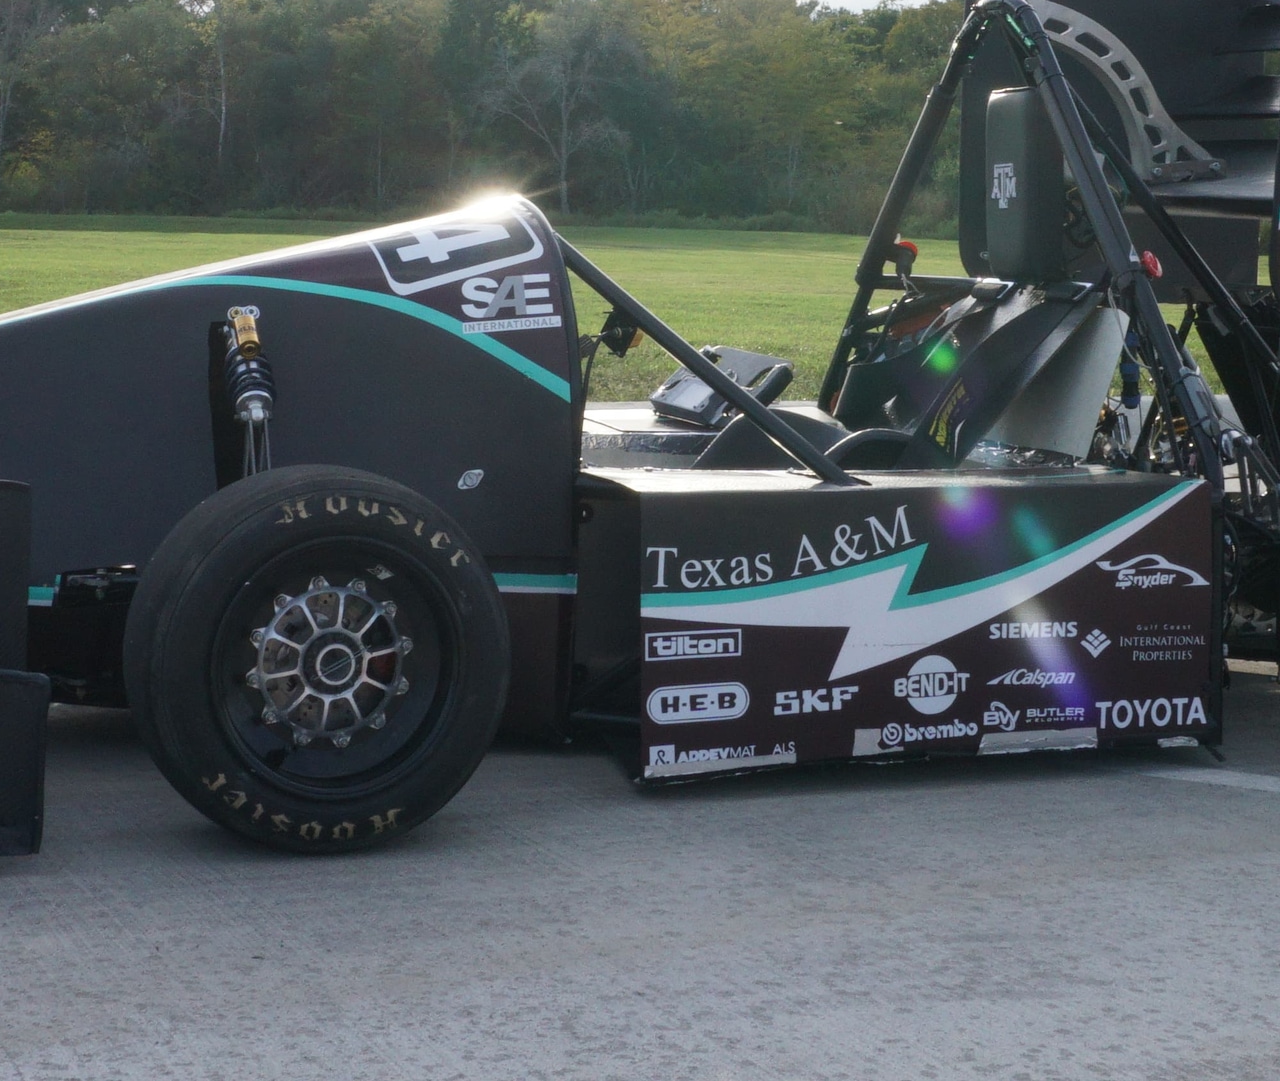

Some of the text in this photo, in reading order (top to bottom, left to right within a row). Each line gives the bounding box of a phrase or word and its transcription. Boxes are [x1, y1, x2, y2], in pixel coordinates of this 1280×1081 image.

[461, 273, 554, 319] SAE
[464, 317, 555, 333] INTERNATIONAL
[646, 505, 916, 588] Texas A&M
[1115, 569, 1176, 589] Snyder
[989, 621, 1078, 639] SIEMENS
[653, 635, 735, 656] tilton
[1010, 668, 1076, 689] Calspan
[774, 686, 859, 716] SKF
[1026, 707, 1085, 718] BUTLER
[1095, 697, 1207, 729] TOYOTA
[904, 720, 979, 742] brembo
